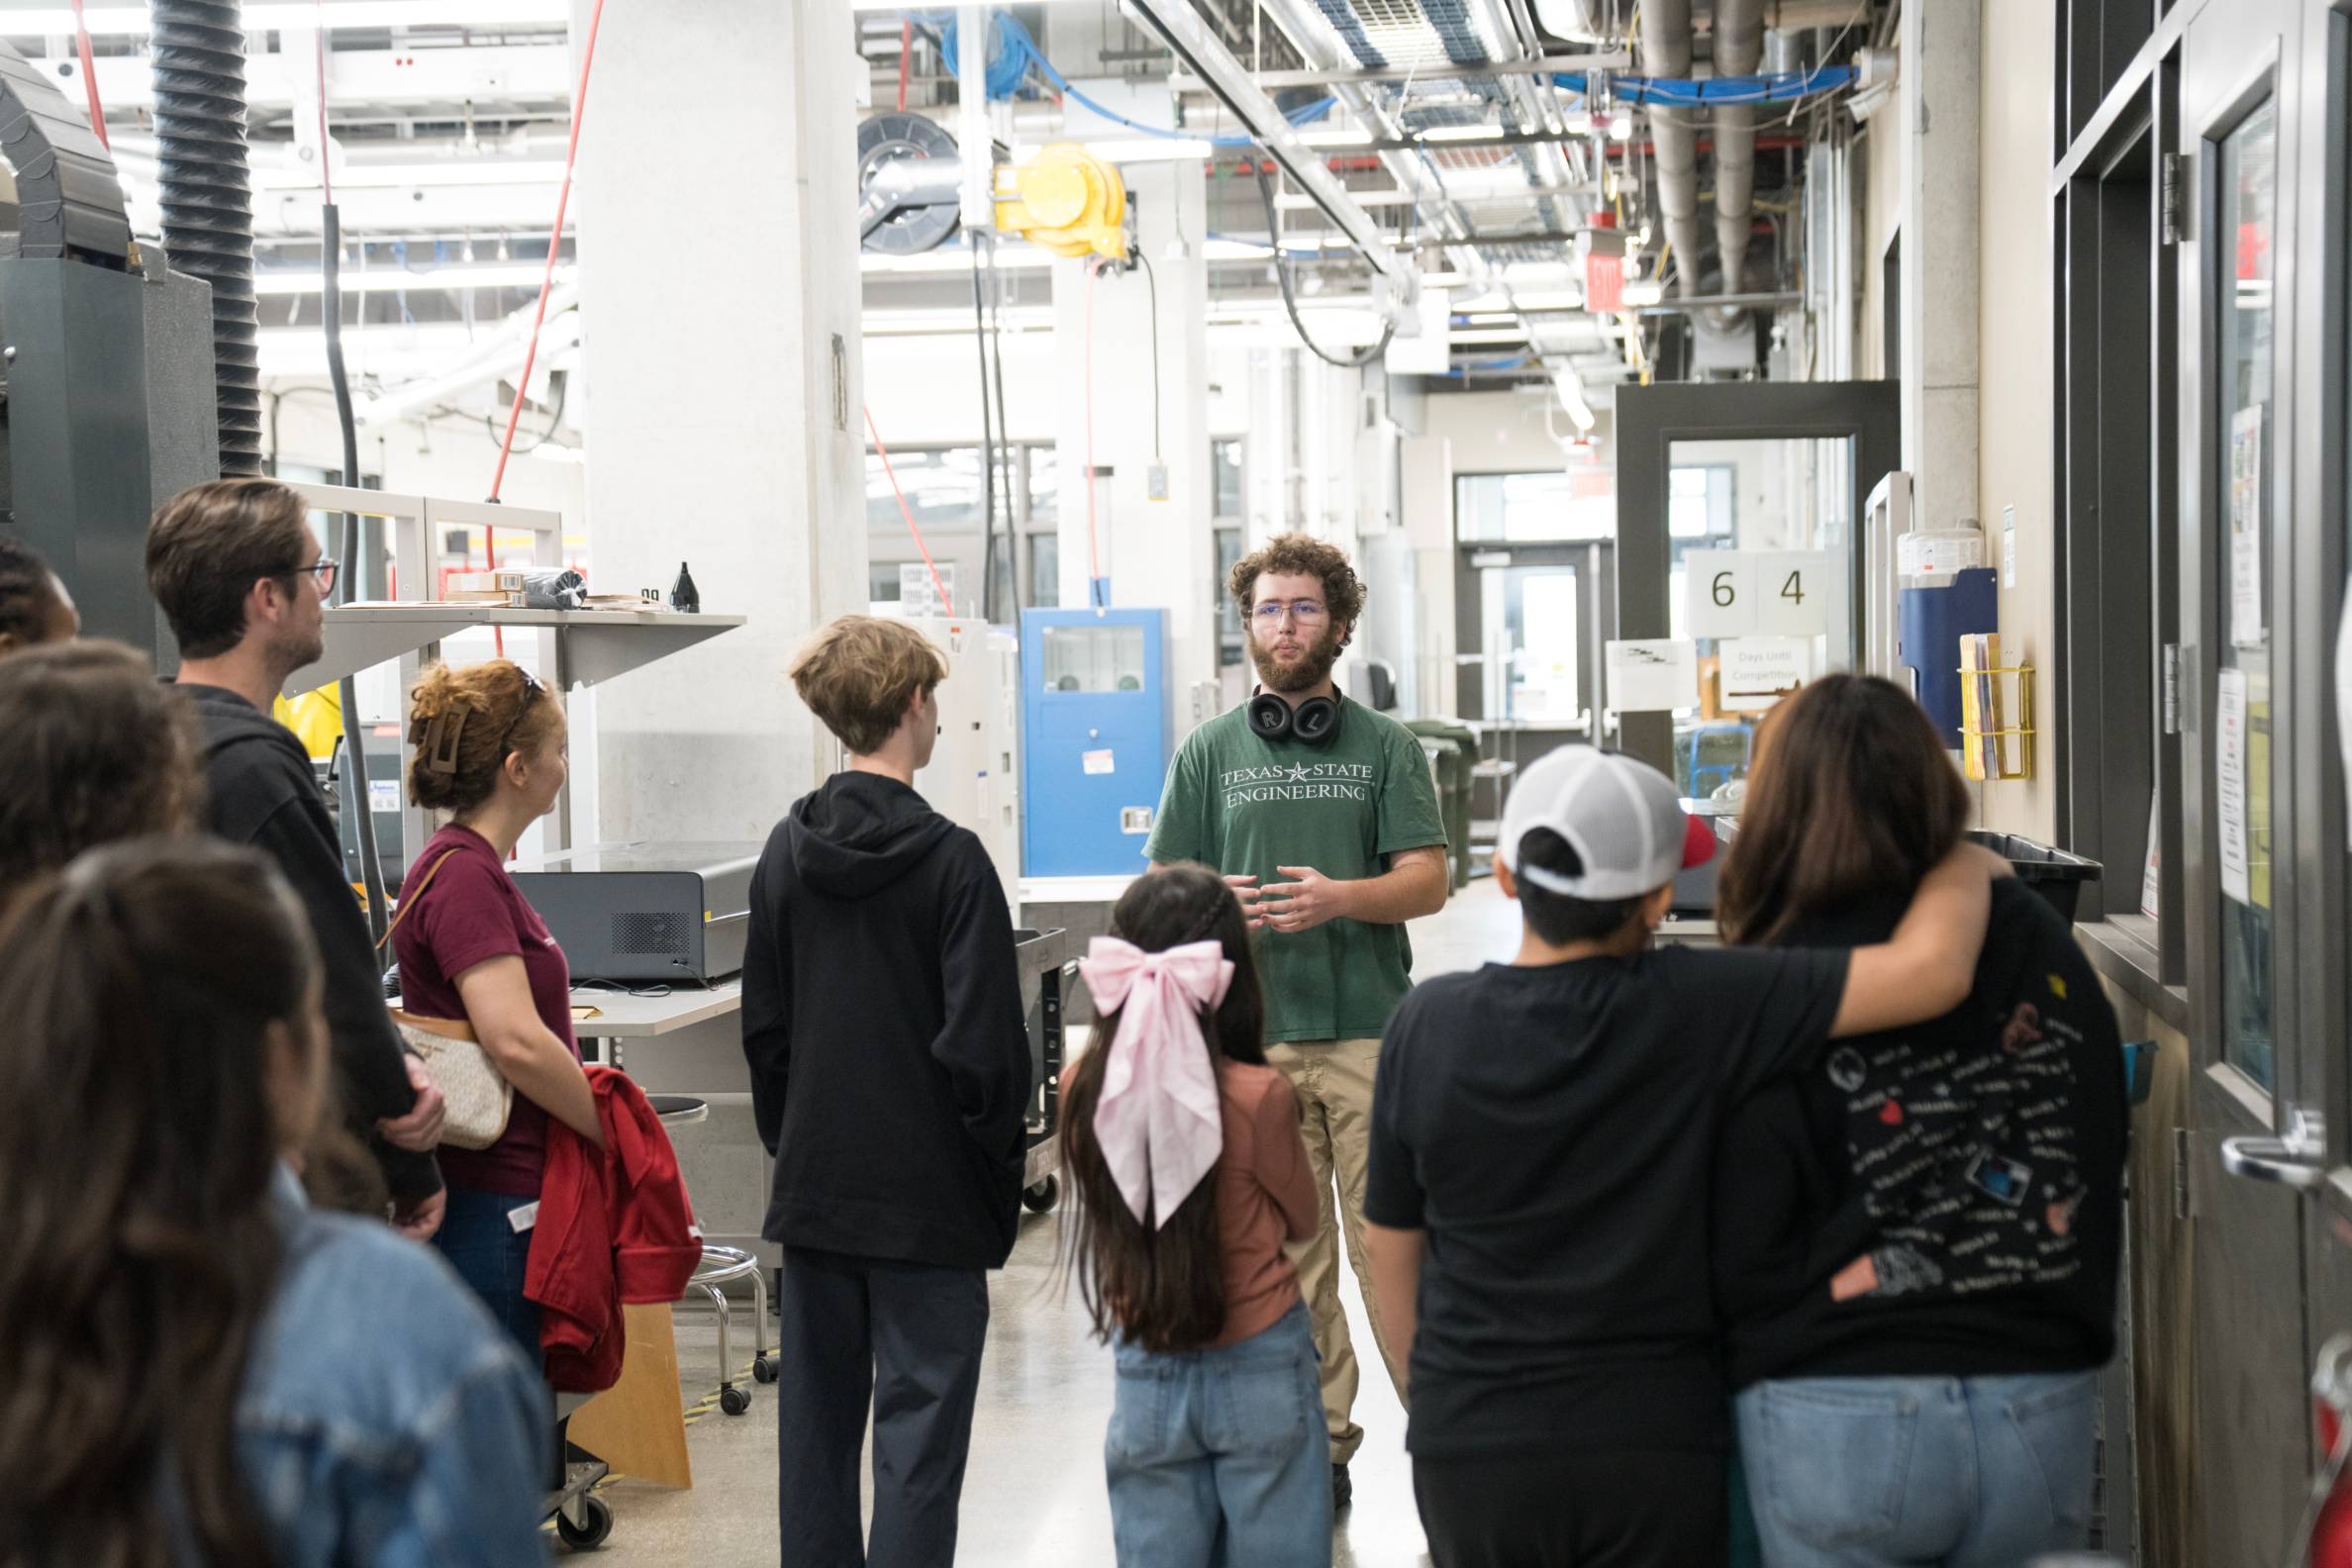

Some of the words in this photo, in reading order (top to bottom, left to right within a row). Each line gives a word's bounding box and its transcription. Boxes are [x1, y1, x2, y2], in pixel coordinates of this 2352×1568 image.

[1712, 571, 1735, 608] 6
[1780, 570, 1806, 606] 4
[1738, 650, 1763, 663] Days
[1766, 648, 1792, 662] Until
[1732, 669, 1798, 682] Competition
[1261, 711, 1277, 728] R
[1307, 713, 1320, 731] L
[1221, 764, 1284, 787] TEXAS
[1313, 763, 1373, 779] STATE
[1226, 785, 1365, 808] ENGINEERING
